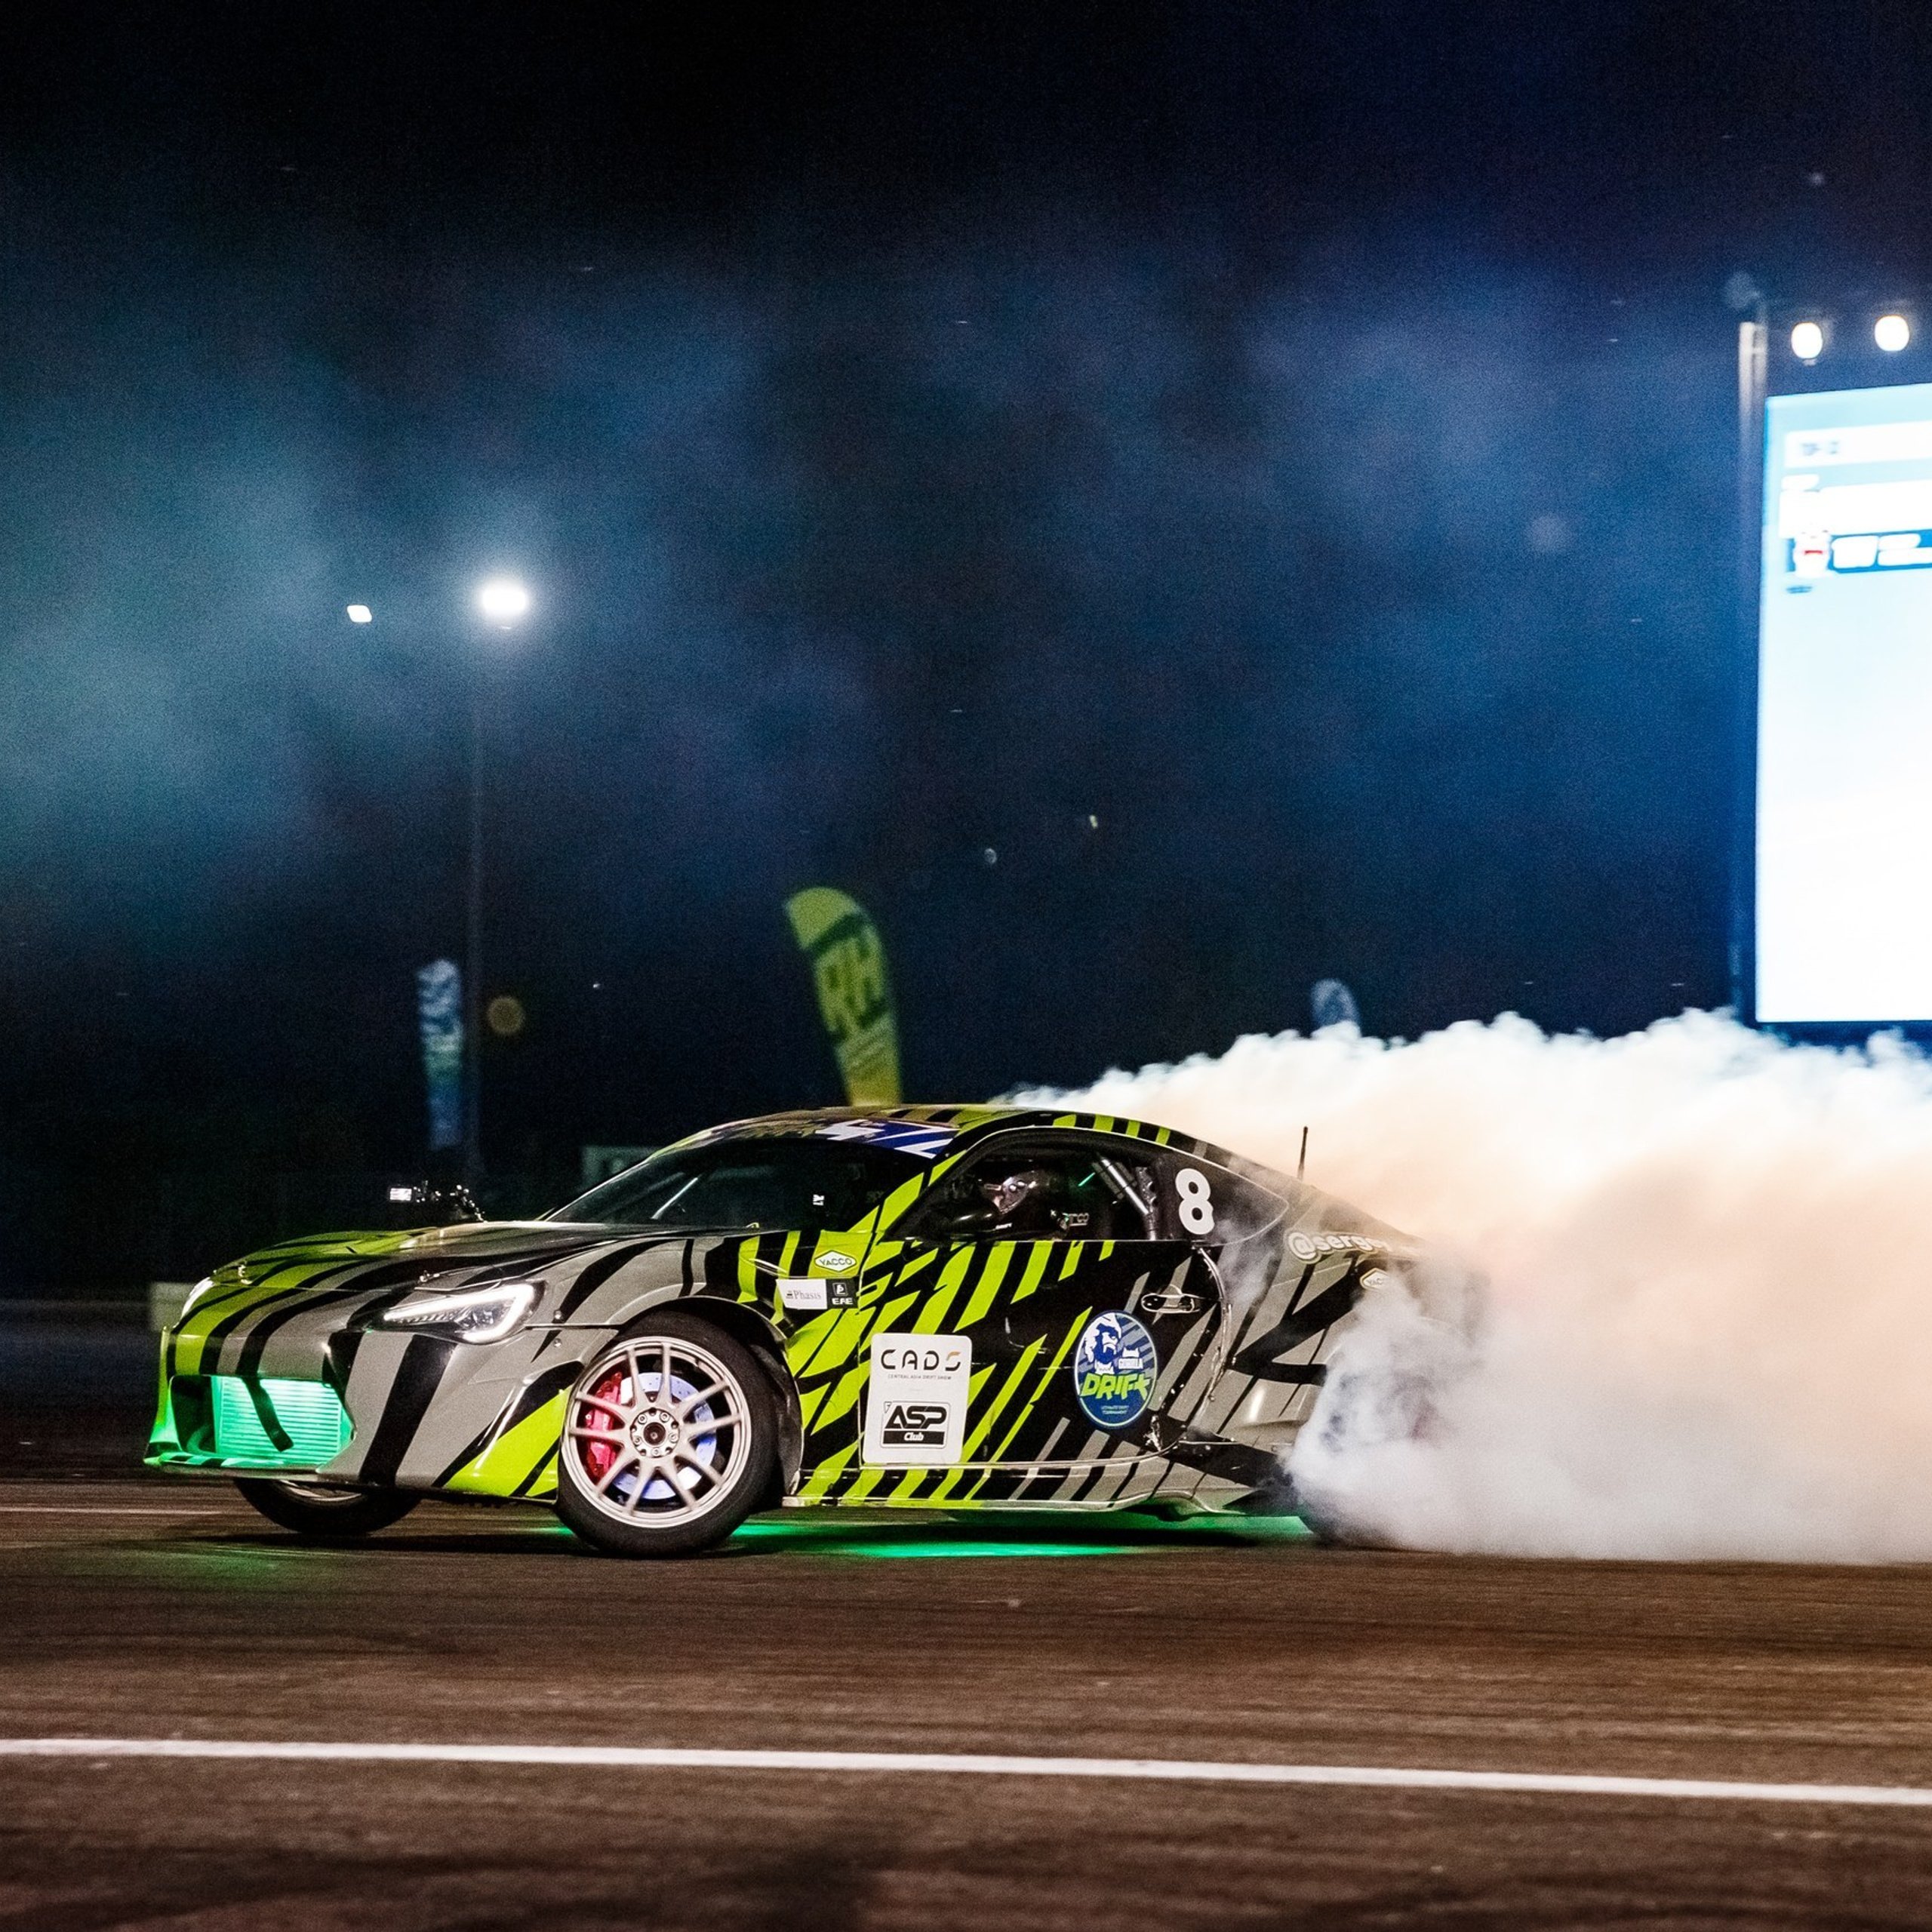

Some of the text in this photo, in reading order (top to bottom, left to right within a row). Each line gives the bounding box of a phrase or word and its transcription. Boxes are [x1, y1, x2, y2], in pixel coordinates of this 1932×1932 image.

[1175, 1168, 1215, 1235] 8
[818, 1258, 853, 1266] YACCO
[793, 1290, 821, 1300] Phasis
[881, 1349, 961, 1371] CADS
[1080, 1373, 1151, 1401] DRIFT
[884, 1405, 947, 1429] ASP
[904, 1432, 924, 1441] Club
